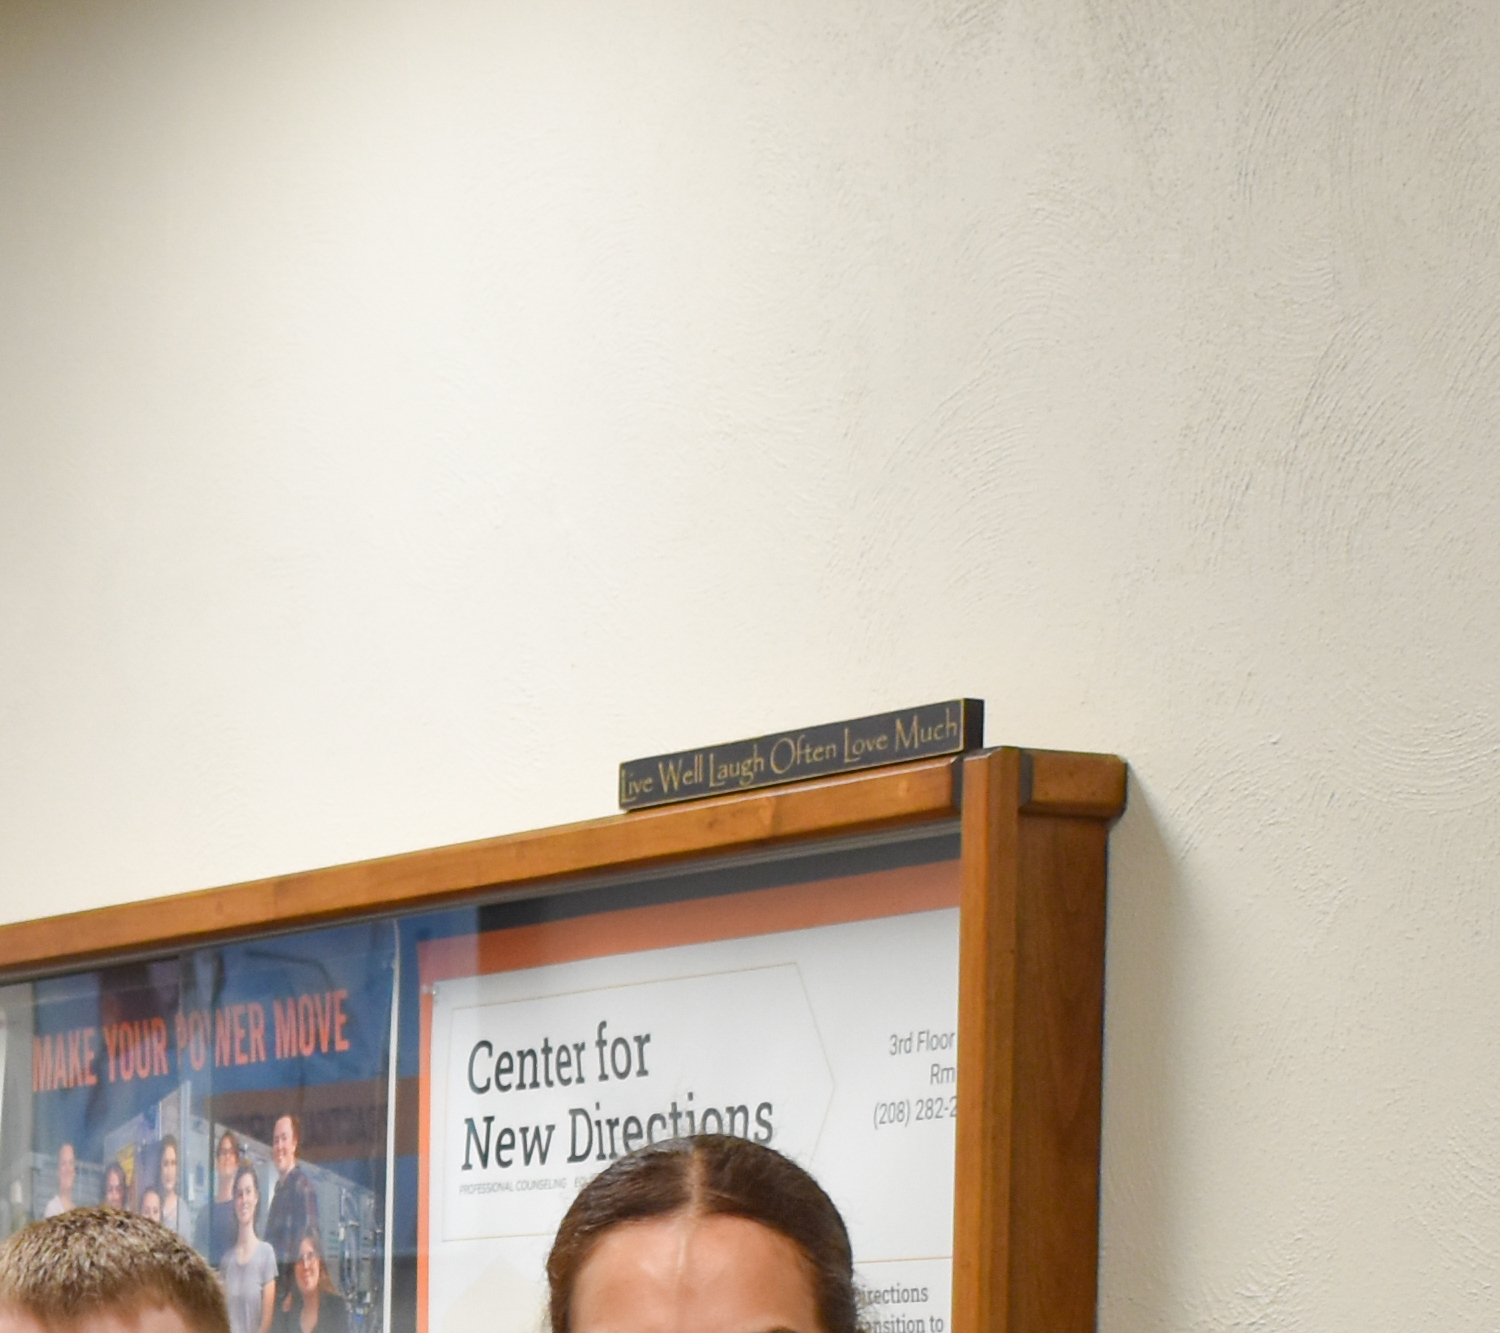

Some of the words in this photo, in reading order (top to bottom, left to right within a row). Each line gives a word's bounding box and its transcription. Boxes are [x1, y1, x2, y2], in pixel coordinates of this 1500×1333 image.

[620, 767, 653, 800] Live
[659, 754, 703, 794] Well
[709, 745, 764, 787] Laugh
[770, 734, 836, 775] Often
[844, 727, 887, 764] Love
[895, 708, 957, 751] Much
[33, 1027, 98, 1092] MAKE
[103, 1017, 168, 1083] YOUR
[273, 989, 350, 1059] MOVE
[467, 1037, 585, 1094] Center
[597, 1020, 651, 1082] for
[889, 1032, 913, 1056] 3rd
[917, 1029, 955, 1052] Floor
[461, 1116, 556, 1170] New
[566, 1091, 774, 1164] Directions
[873, 1099, 911, 1130] (208)
[459, 1180, 515, 1194] PROFESSIONAL
[516, 1177, 567, 1191] COUNSELING
